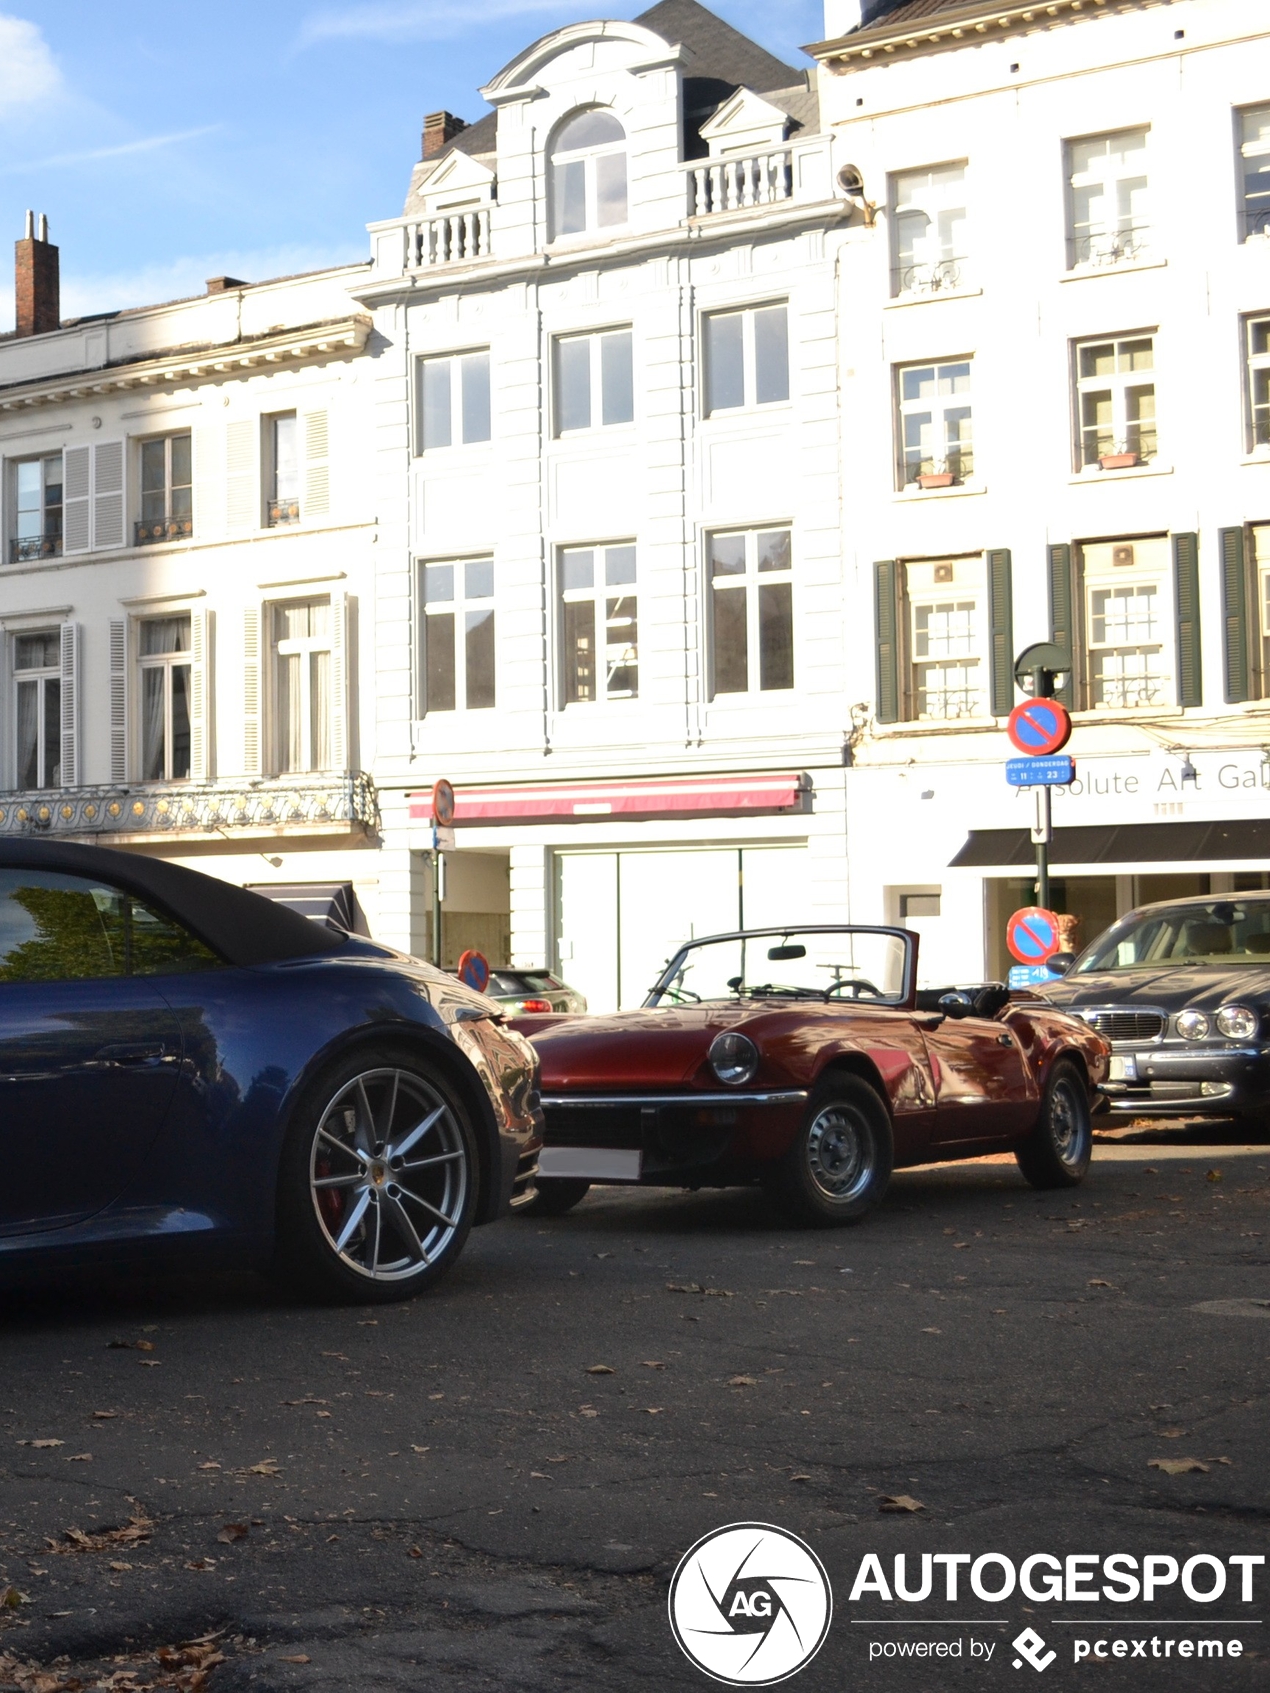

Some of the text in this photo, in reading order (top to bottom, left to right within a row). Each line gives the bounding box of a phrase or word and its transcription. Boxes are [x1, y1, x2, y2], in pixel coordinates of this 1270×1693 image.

[1031, 760, 1069, 768] DONDERDAG
[1020, 772, 1028, 780] 11
[1046, 770, 1059, 778] 23
[1015, 771, 1139, 798] solute
